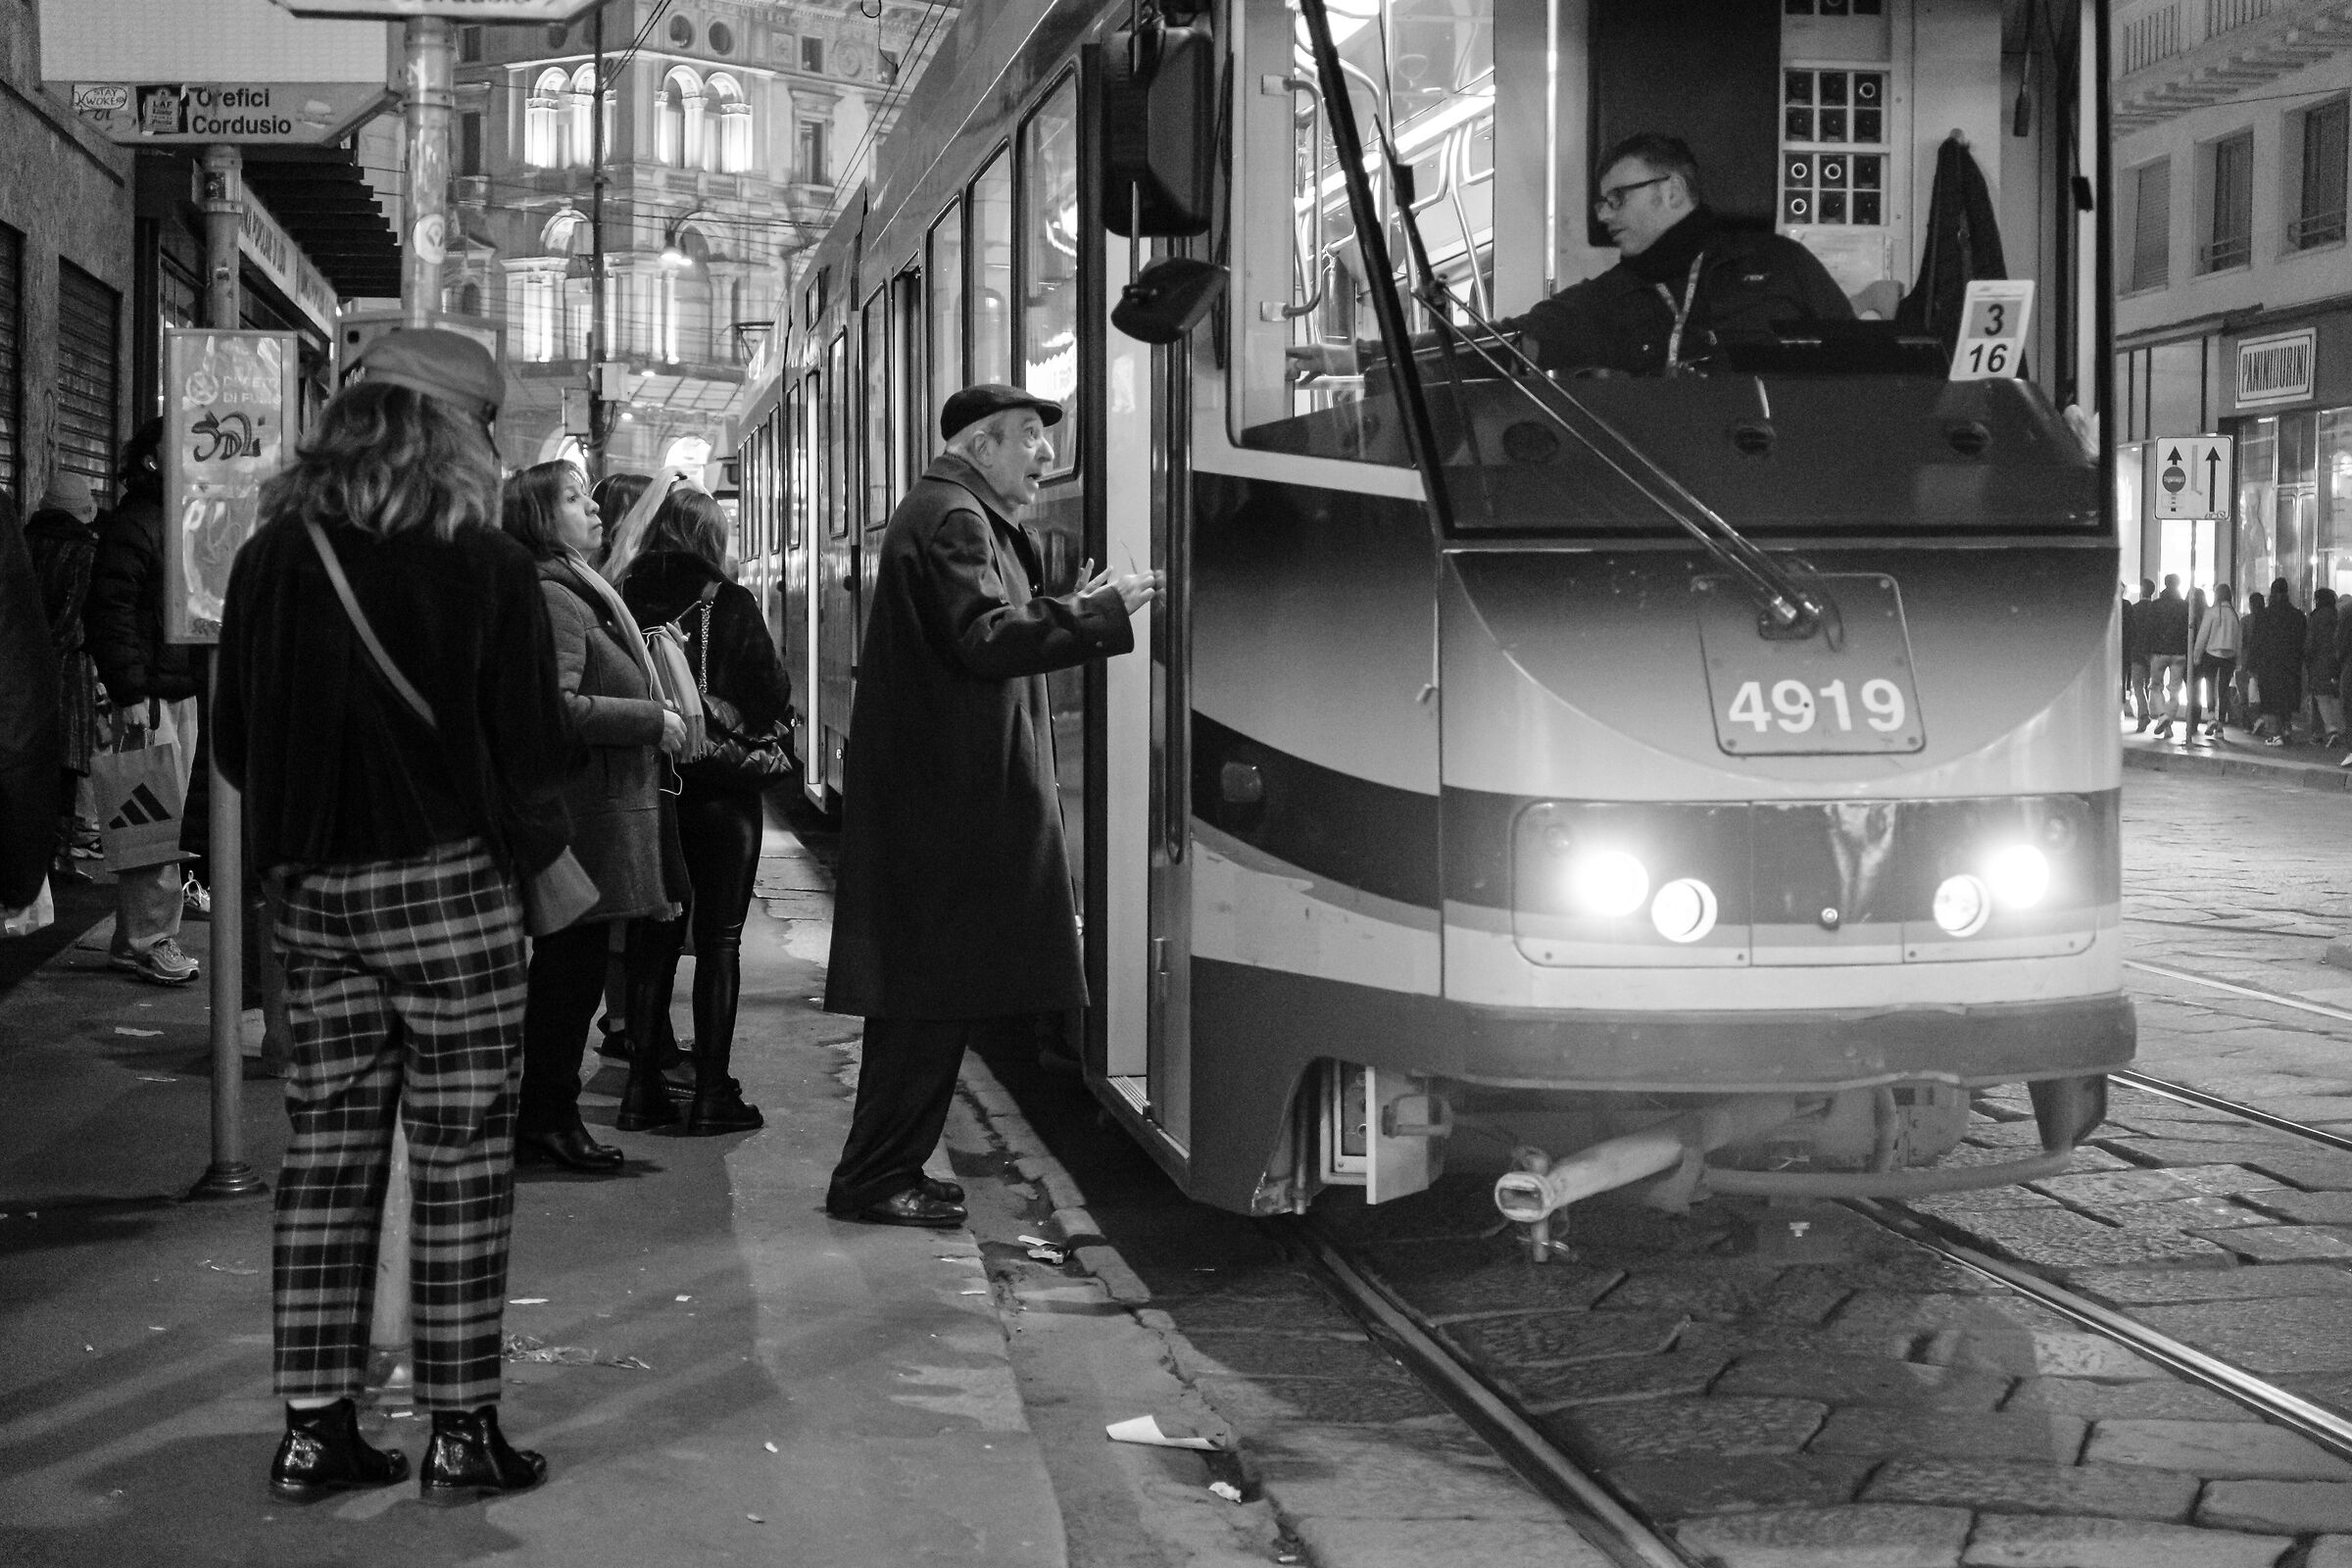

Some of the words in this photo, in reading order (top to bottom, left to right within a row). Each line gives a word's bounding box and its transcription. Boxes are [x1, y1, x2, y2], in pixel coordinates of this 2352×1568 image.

[196, 86, 270, 107] Orefici
[192, 115, 291, 134] Cordusio
[1984, 303, 2004, 336] 3
[1970, 343, 2008, 373] 16
[222, 392, 237, 403] DI
[1729, 679, 1905, 733] 4919
